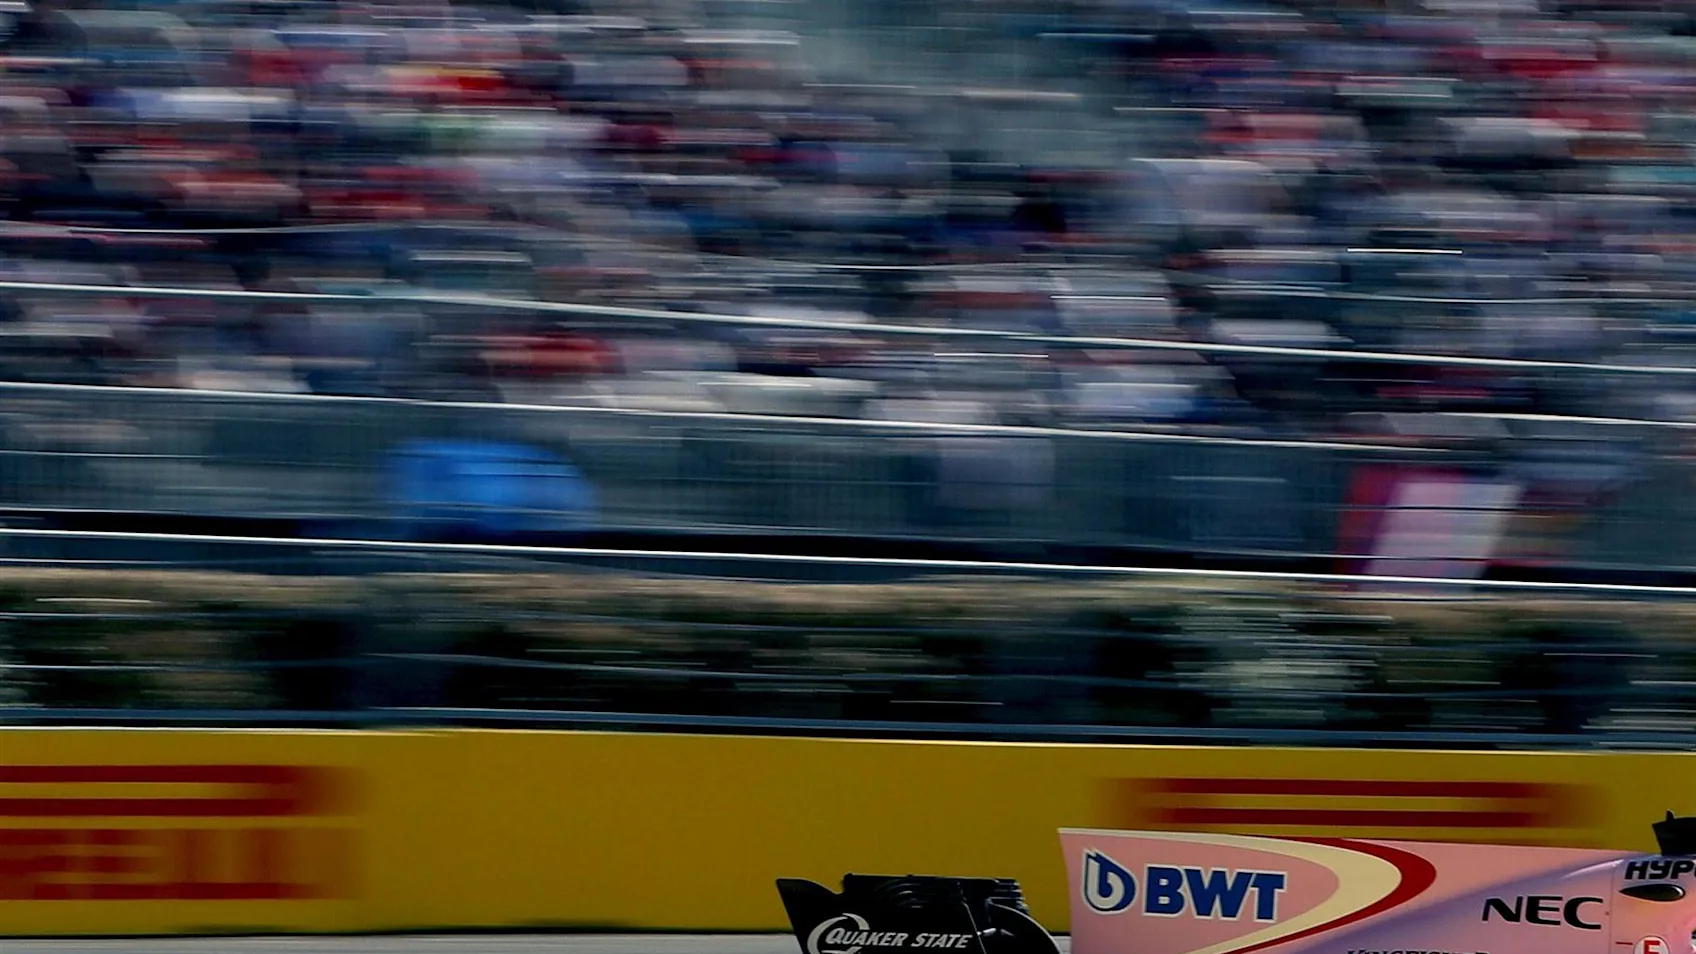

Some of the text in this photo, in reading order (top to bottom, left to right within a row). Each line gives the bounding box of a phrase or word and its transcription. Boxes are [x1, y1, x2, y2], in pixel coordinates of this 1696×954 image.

[1143, 864, 1287, 923] BWT
[1481, 896, 1604, 930] NEC
[825, 927, 973, 948] QUAKER STATE
